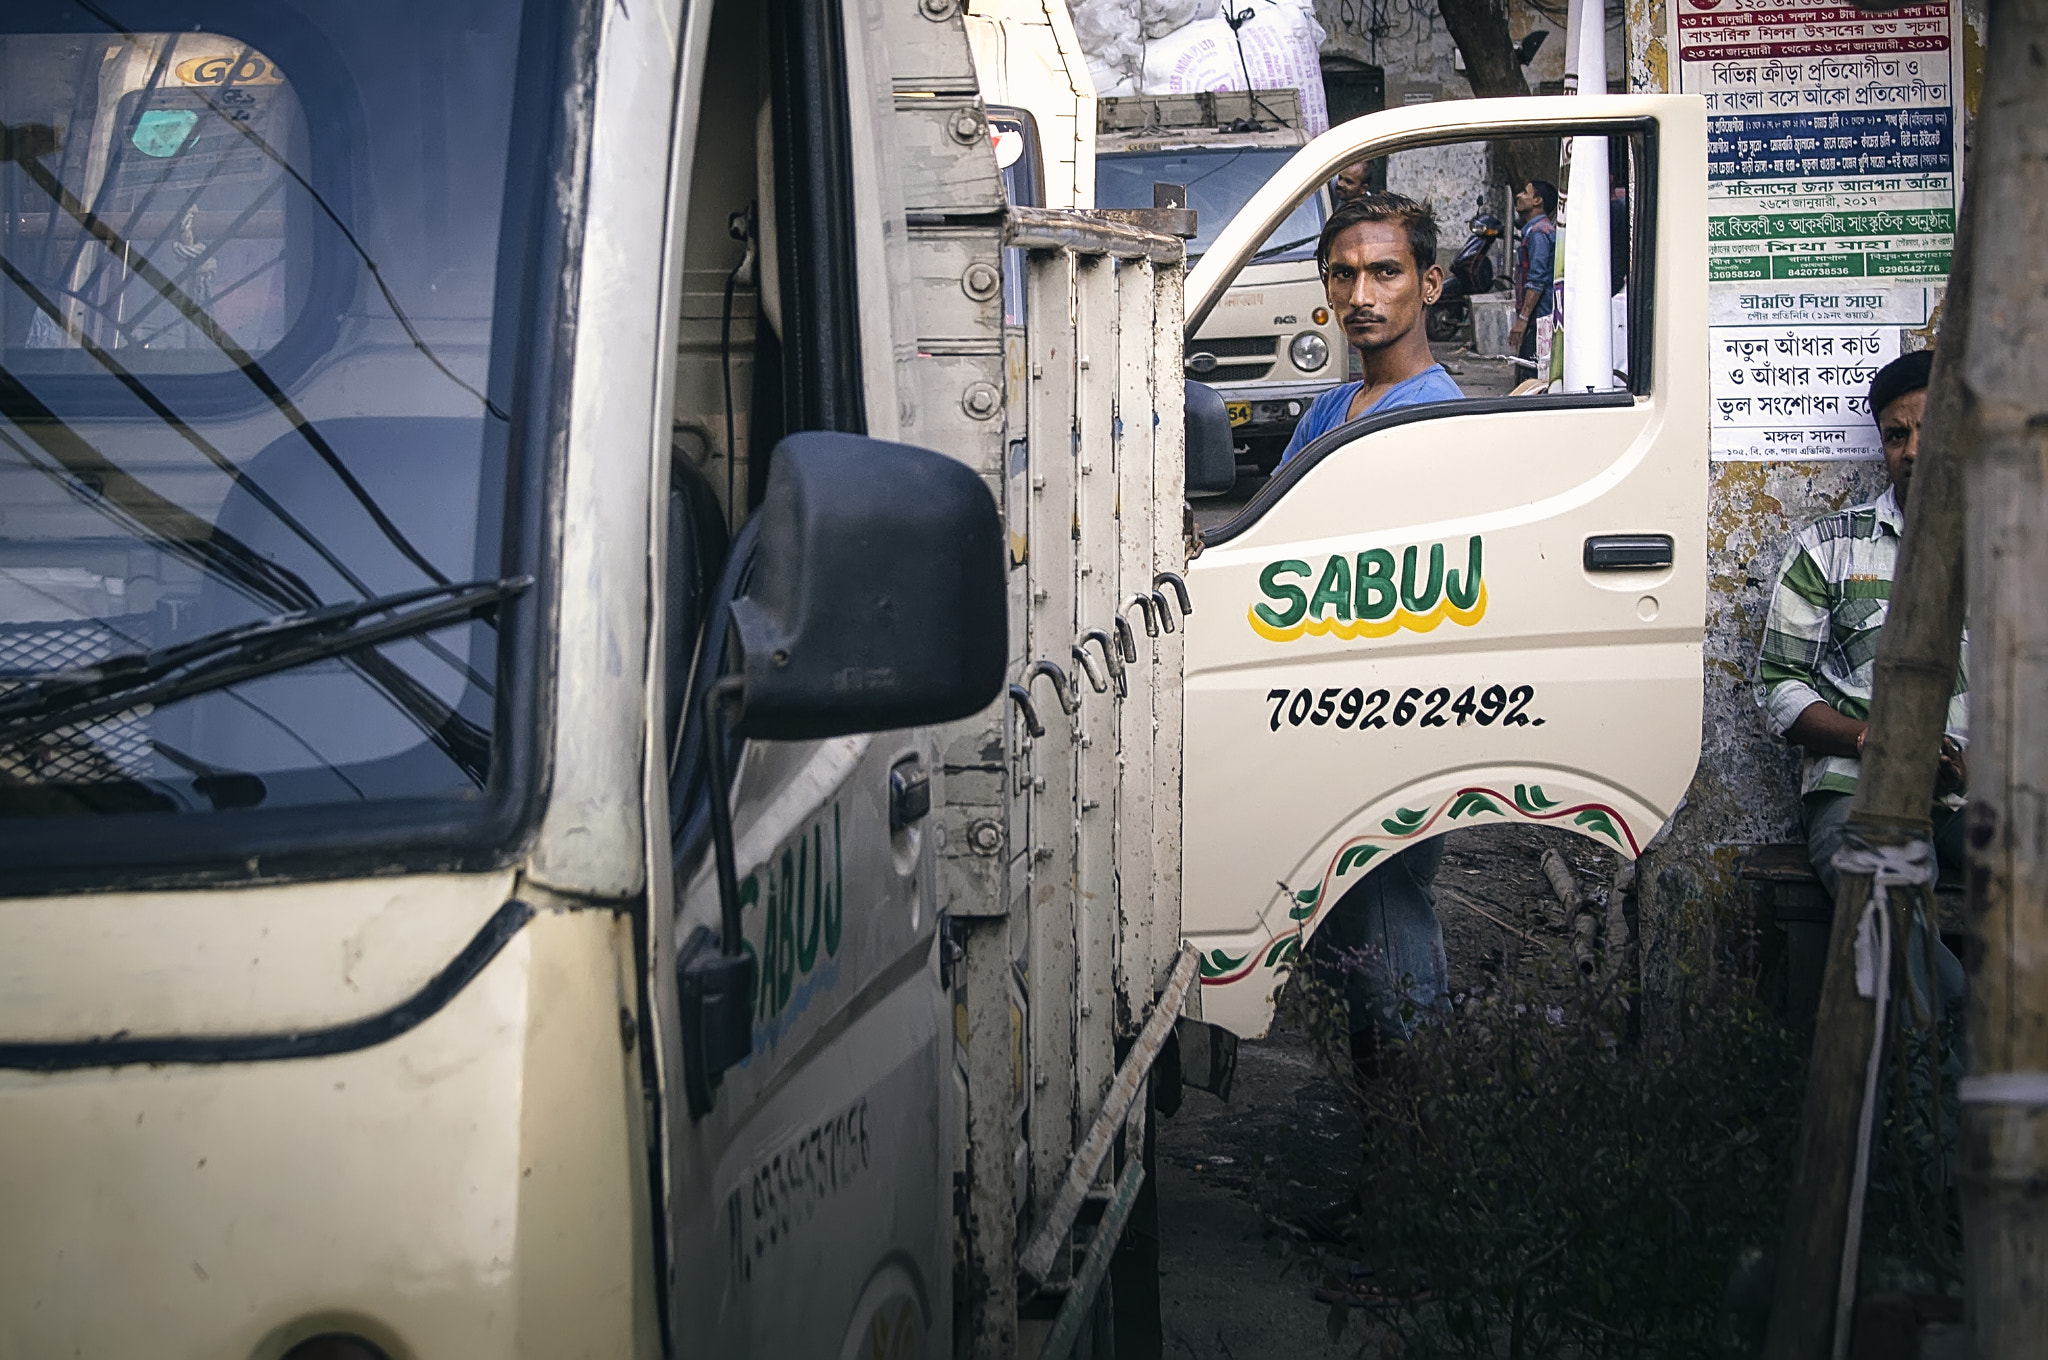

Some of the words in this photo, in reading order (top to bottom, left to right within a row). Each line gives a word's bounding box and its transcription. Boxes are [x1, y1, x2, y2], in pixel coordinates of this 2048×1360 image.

[1681, 17, 1697, 27] ২৩
[1757, 13, 1784, 24] ২০১৭
[1821, 11, 1835, 20] ১০
[1687, 26, 1751, 43] বাৎসরিক
[1758, 25, 1796, 40] মিলন
[1803, 22, 1865, 38] উৎসবের
[1871, 22, 1898, 34] শুভ
[1904, 20, 1942, 36] সূচনা
[1688, 49, 1706, 59] ২৩
[1780, 45, 1811, 54] থেকে
[1814, 43, 1833, 53] ২৬
[1907, 39, 1943, 49] ২০১৭
[1711, 62, 1757, 86] বিভিন্ন
[1761, 59, 1803, 86] ক্রীড়া
[1807, 57, 1900, 81] প্রতিযোগীতা
[1905, 62, 1919, 76] ও
[1723, 90, 1764, 111] বাংলা
[1768, 87, 1800, 107] বসে
[1802, 82, 1850, 106] আঁকো
[1855, 78, 1948, 105] প্রতিযোগীতা
[1725, 180, 1798, 197] মহিলাদের
[1801, 180, 1834, 194] জন্য
[1838, 178, 1902, 193] আলপনা
[1905, 173, 1948, 190] আঁকা
[1843, 195, 1878, 207] ২০১৭
[1728, 215, 1772, 237] বিতরণী
[1772, 219, 1785, 232] ও
[1787, 211, 1845, 234] আকর্ষণীয়
[1848, 211, 1904, 235] সাংস্কৃতিক
[1906, 209, 1952, 233] অনুষ্ঠান
[1764, 240, 1827, 253] শিখা
[1834, 240, 1891, 250] সাহা
[1787, 267, 1849, 277] 8420738536
[1878, 264, 1941, 274] 8296542776
[1739, 294, 1795, 310] শ্রীমতি
[1799, 293, 1840, 309] শিখা
[1844, 294, 1883, 309] সাহা
[1724, 338, 1769, 363] নতুন
[1774, 331, 1835, 356] আঁধার
[1839, 329, 1881, 356] কার্ড
[1728, 368, 1744, 385] ও
[1750, 361, 1810, 387] আঁধার
[1716, 397, 1752, 422] ভুল
[1757, 393, 1840, 416] সংশোধন
[1763, 430, 1804, 444] মঙ্গল
[1809, 430, 1846, 444] সদন
[1254, 535, 1483, 628] SABUJ
[1266, 684, 1546, 732] 7059262492.
